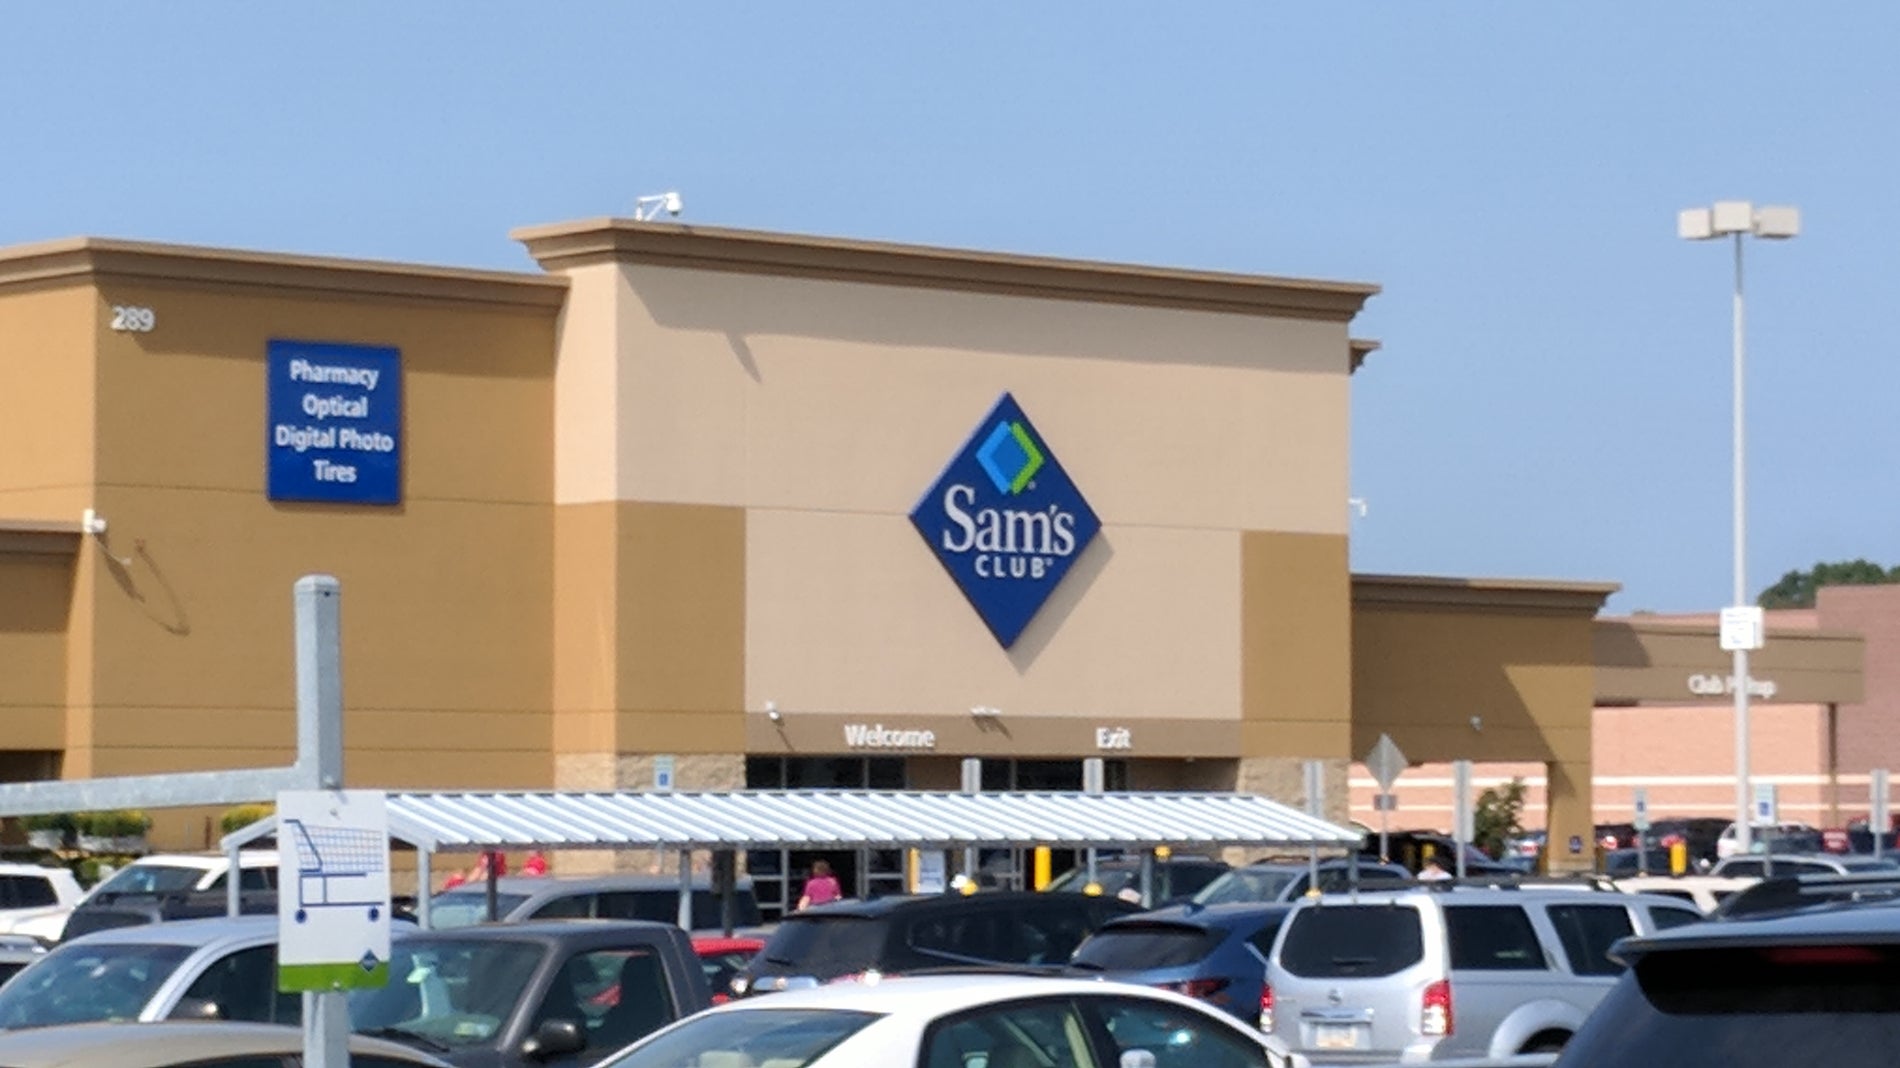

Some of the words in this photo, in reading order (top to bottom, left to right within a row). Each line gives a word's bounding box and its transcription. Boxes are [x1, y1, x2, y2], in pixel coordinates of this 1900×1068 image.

[111, 306, 155, 332] 289
[289, 359, 379, 390] Pharmacy
[302, 393, 368, 420] Optical
[275, 424, 335, 452] Digital
[339, 428, 394, 452] Photo
[313, 459, 357, 483] Tires
[943, 484, 1076, 556] Sam's
[1687, 674, 1724, 695] Club
[843, 723, 936, 748] Welcome
[1095, 726, 1132, 749] Exit
